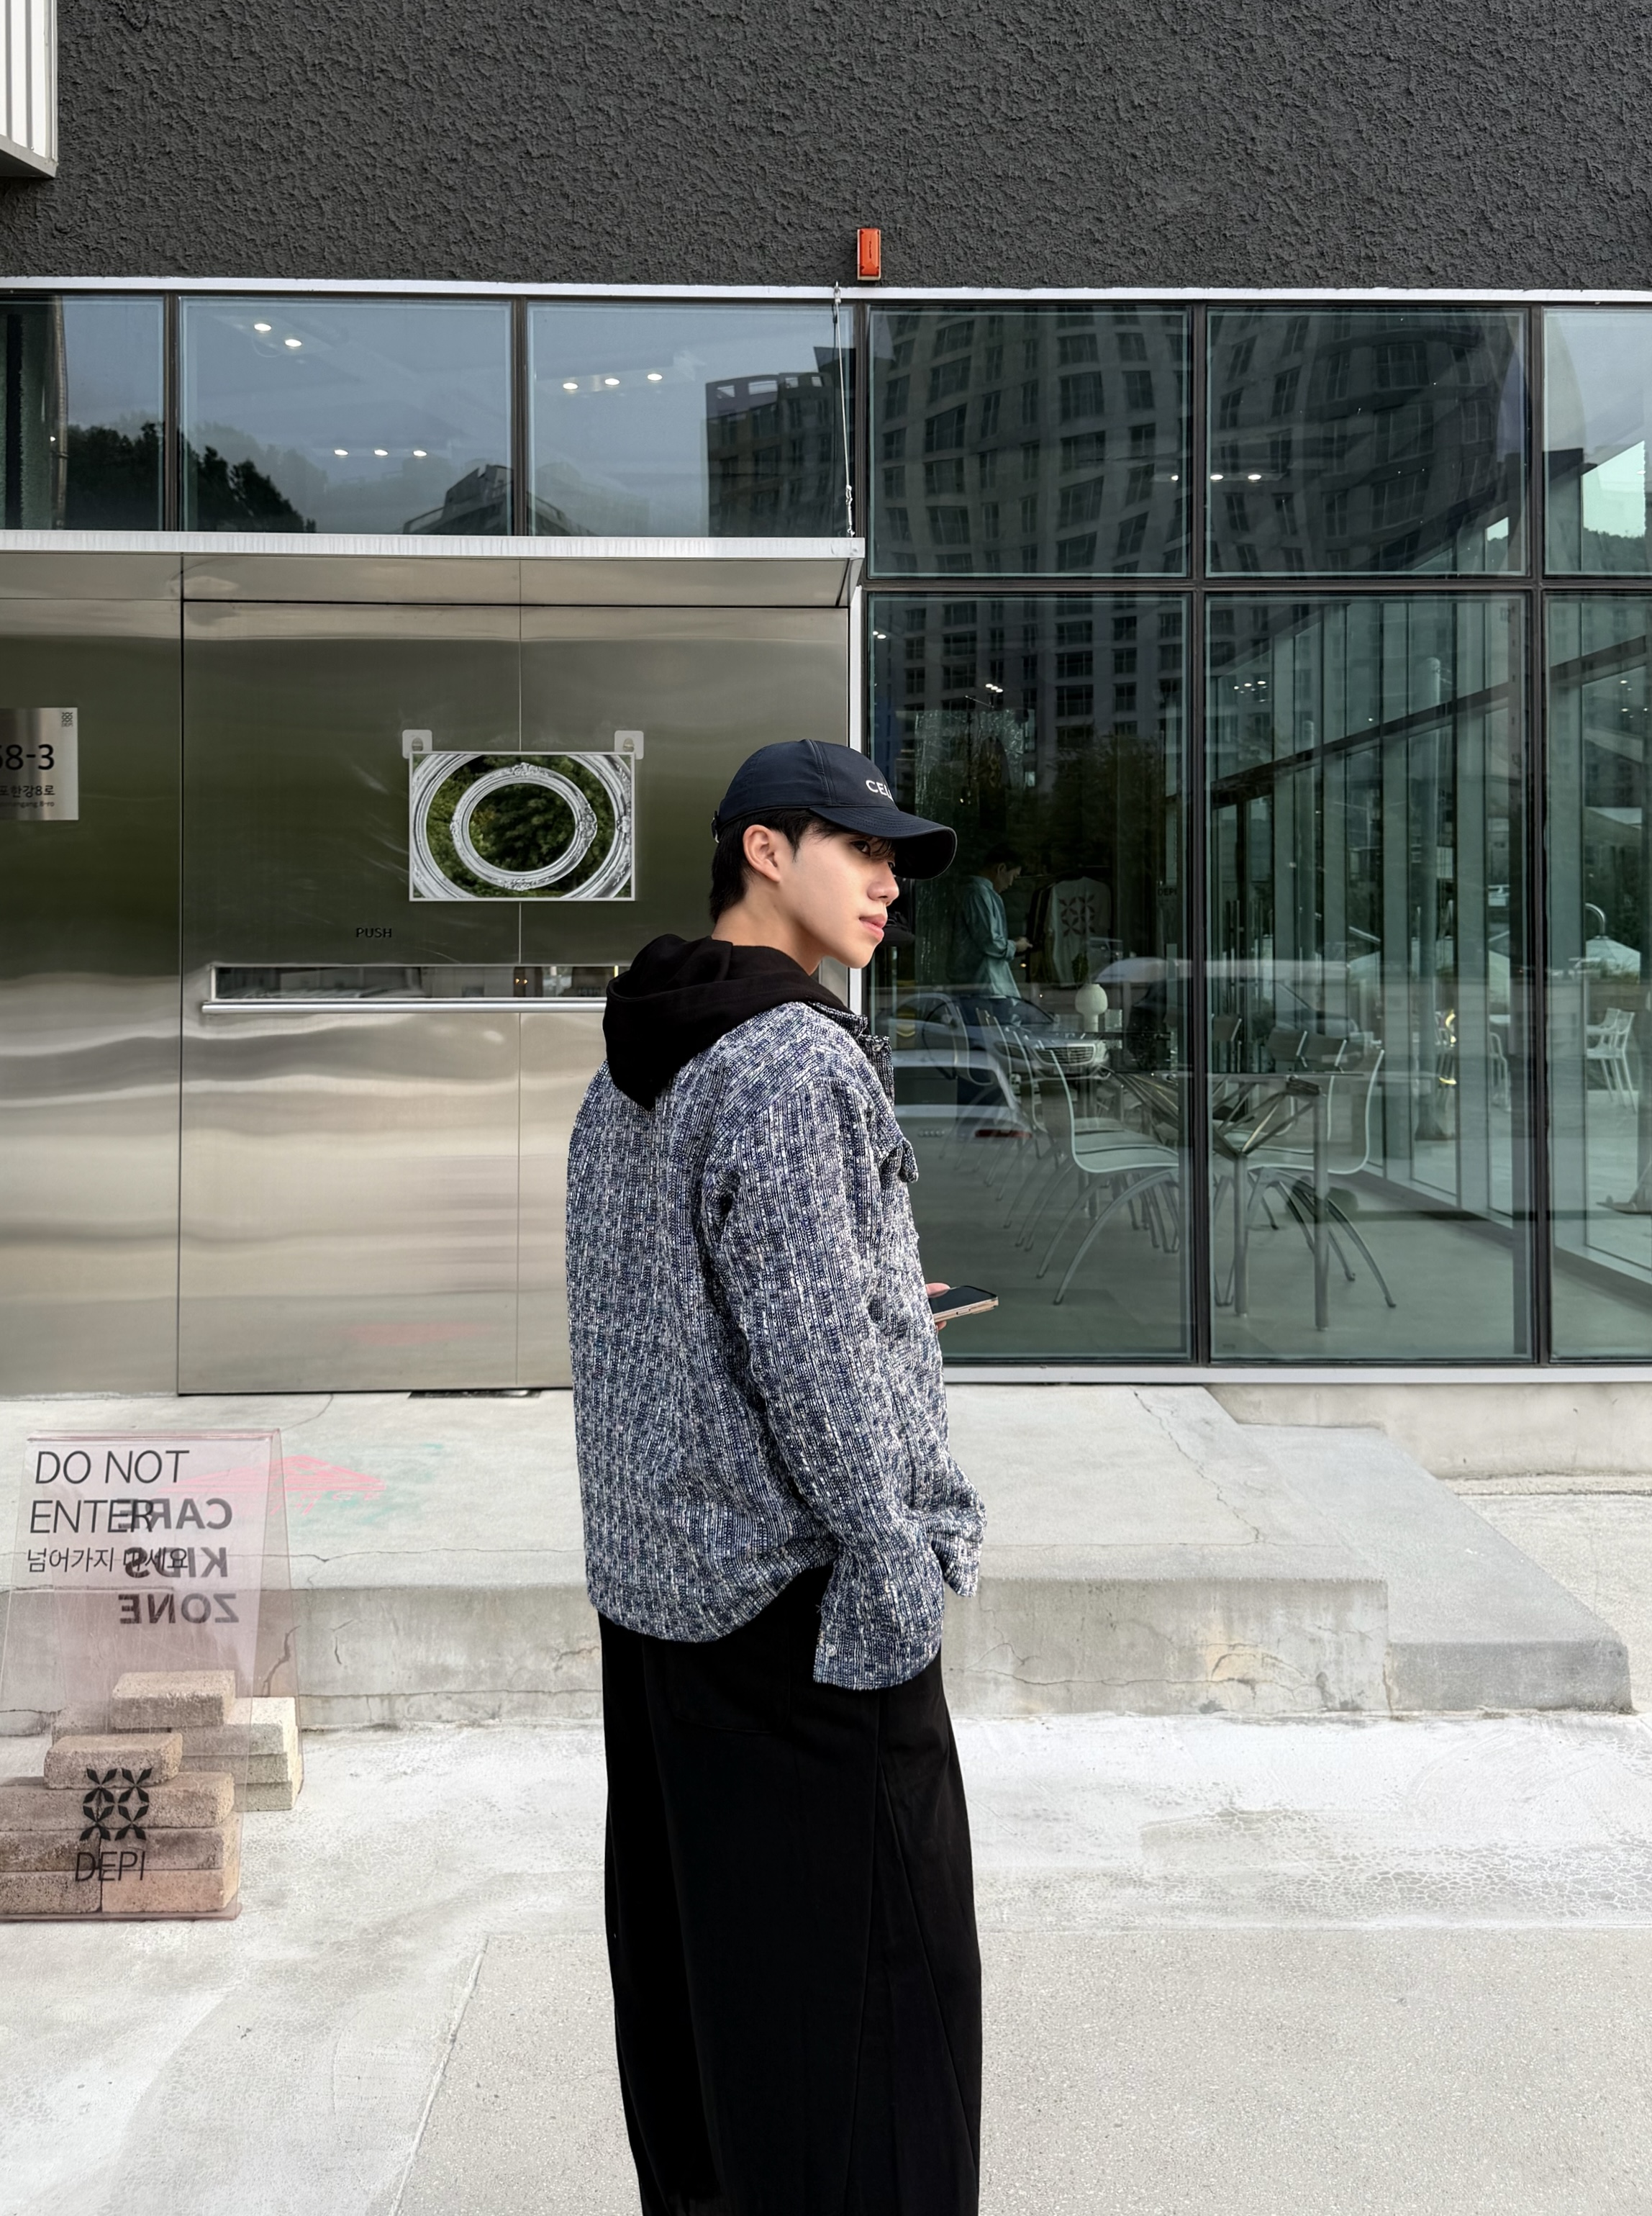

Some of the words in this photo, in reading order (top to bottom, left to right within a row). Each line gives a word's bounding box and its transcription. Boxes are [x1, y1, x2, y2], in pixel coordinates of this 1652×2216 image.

[0, 744, 55, 770] 8-3
[356, 927, 392, 938] PUSH
[35, 1450, 92, 1484] DO
[104, 1450, 190, 1484] NOT
[30, 1499, 154, 1533] ENTER
[27, 1547, 114, 1573] 넘어가지
[75, 1851, 146, 1882] DEPI
